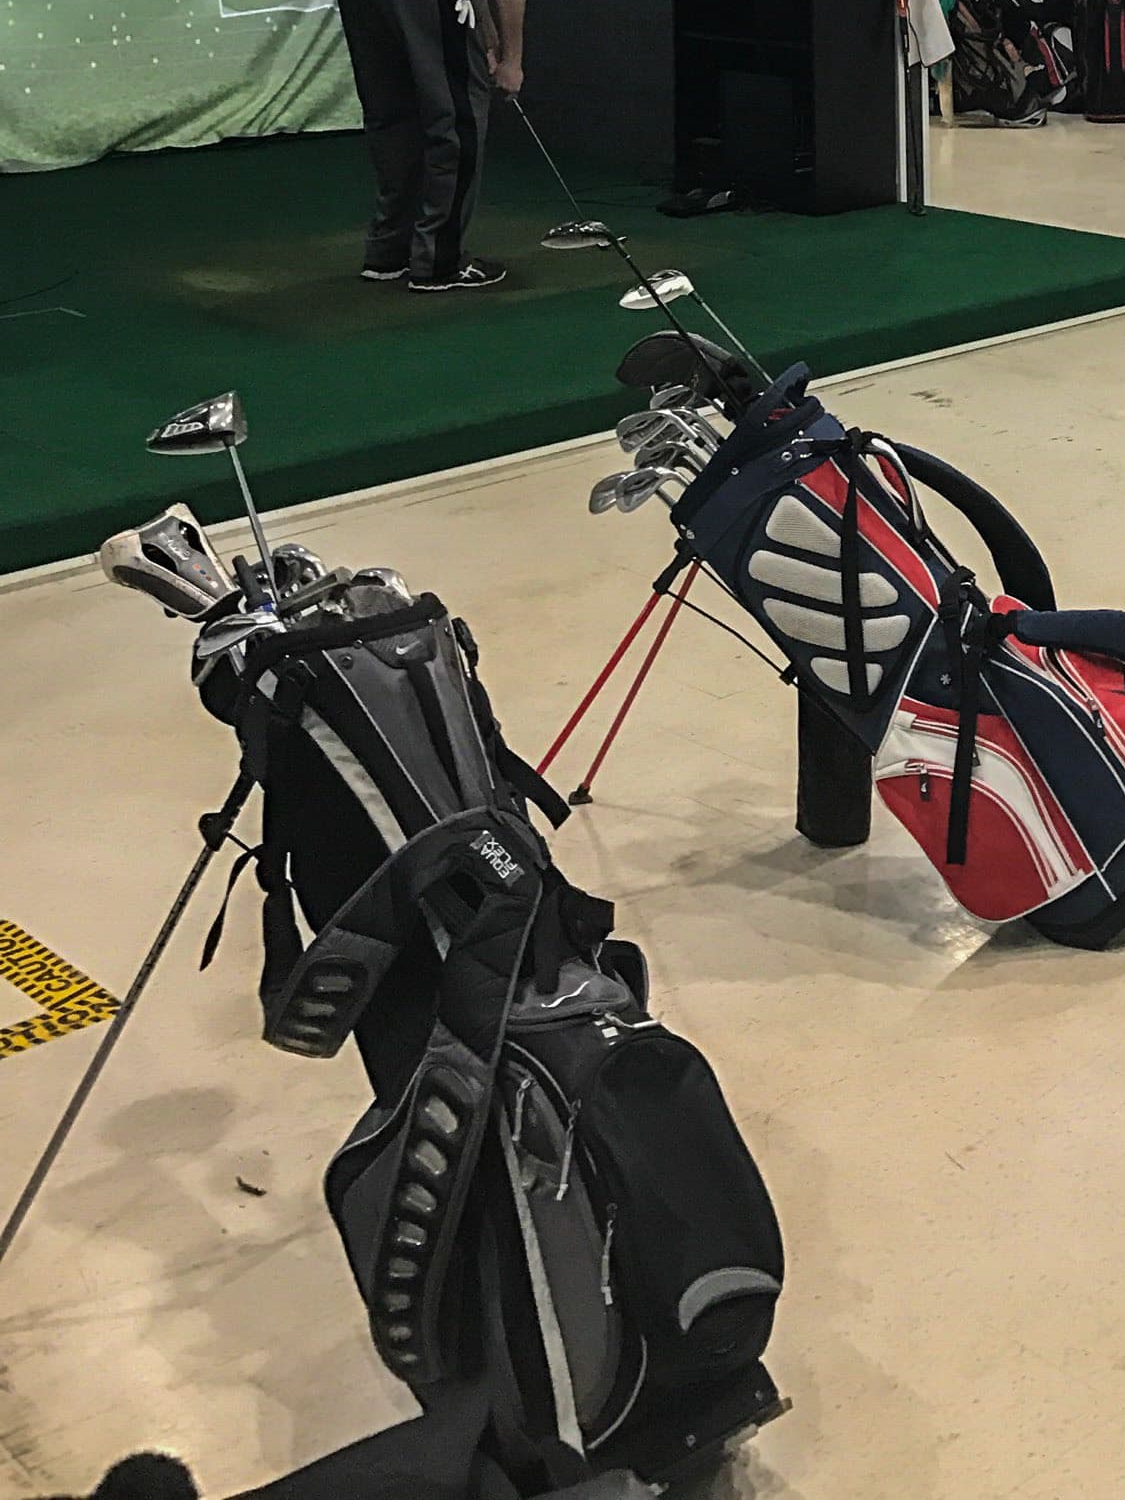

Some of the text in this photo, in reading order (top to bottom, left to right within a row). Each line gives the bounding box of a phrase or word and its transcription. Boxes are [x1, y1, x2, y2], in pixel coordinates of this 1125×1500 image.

[480, 844, 510, 879] EQUA
[486, 836, 518, 871] FLEX
[0, 933, 73, 993] CAUTIO
